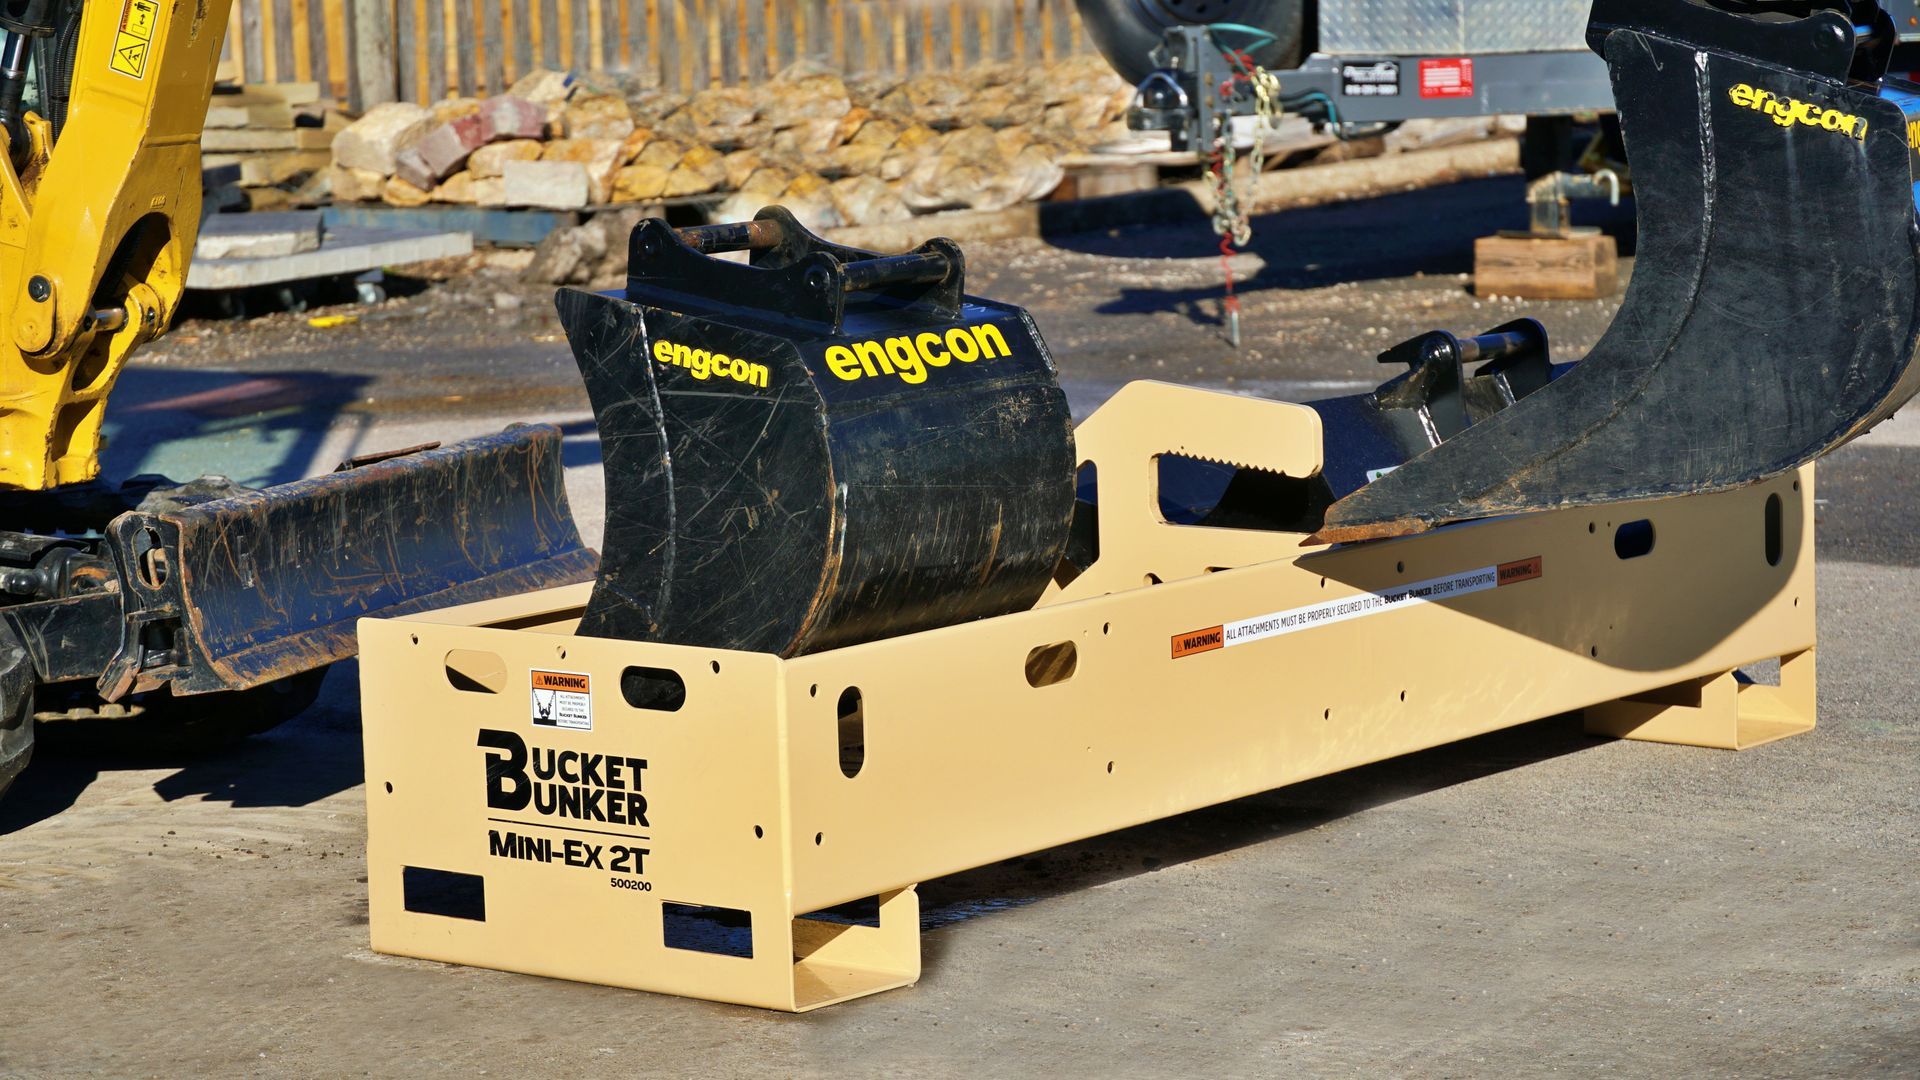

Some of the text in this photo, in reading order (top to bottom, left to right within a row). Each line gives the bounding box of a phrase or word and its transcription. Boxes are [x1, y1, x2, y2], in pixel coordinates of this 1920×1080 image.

[1728, 83, 1868, 144] engcon
[653, 339, 769, 388] engcon
[825, 322, 1013, 384] engcon
[1500, 564, 1532, 580] WARNING
[1226, 572, 1496, 640] ALL ATTACHMENTS MUST BE PROPERLY SECURED TO THE BUCKET BUNKER BEFORE TRANSPORTING
[1183, 632, 1221, 651] WARNING
[543, 675, 586, 689] WARNING
[477, 728, 648, 792] BUCKET
[488, 829, 650, 875] MINI-EX 2T
[610, 877, 652, 892] 500200
